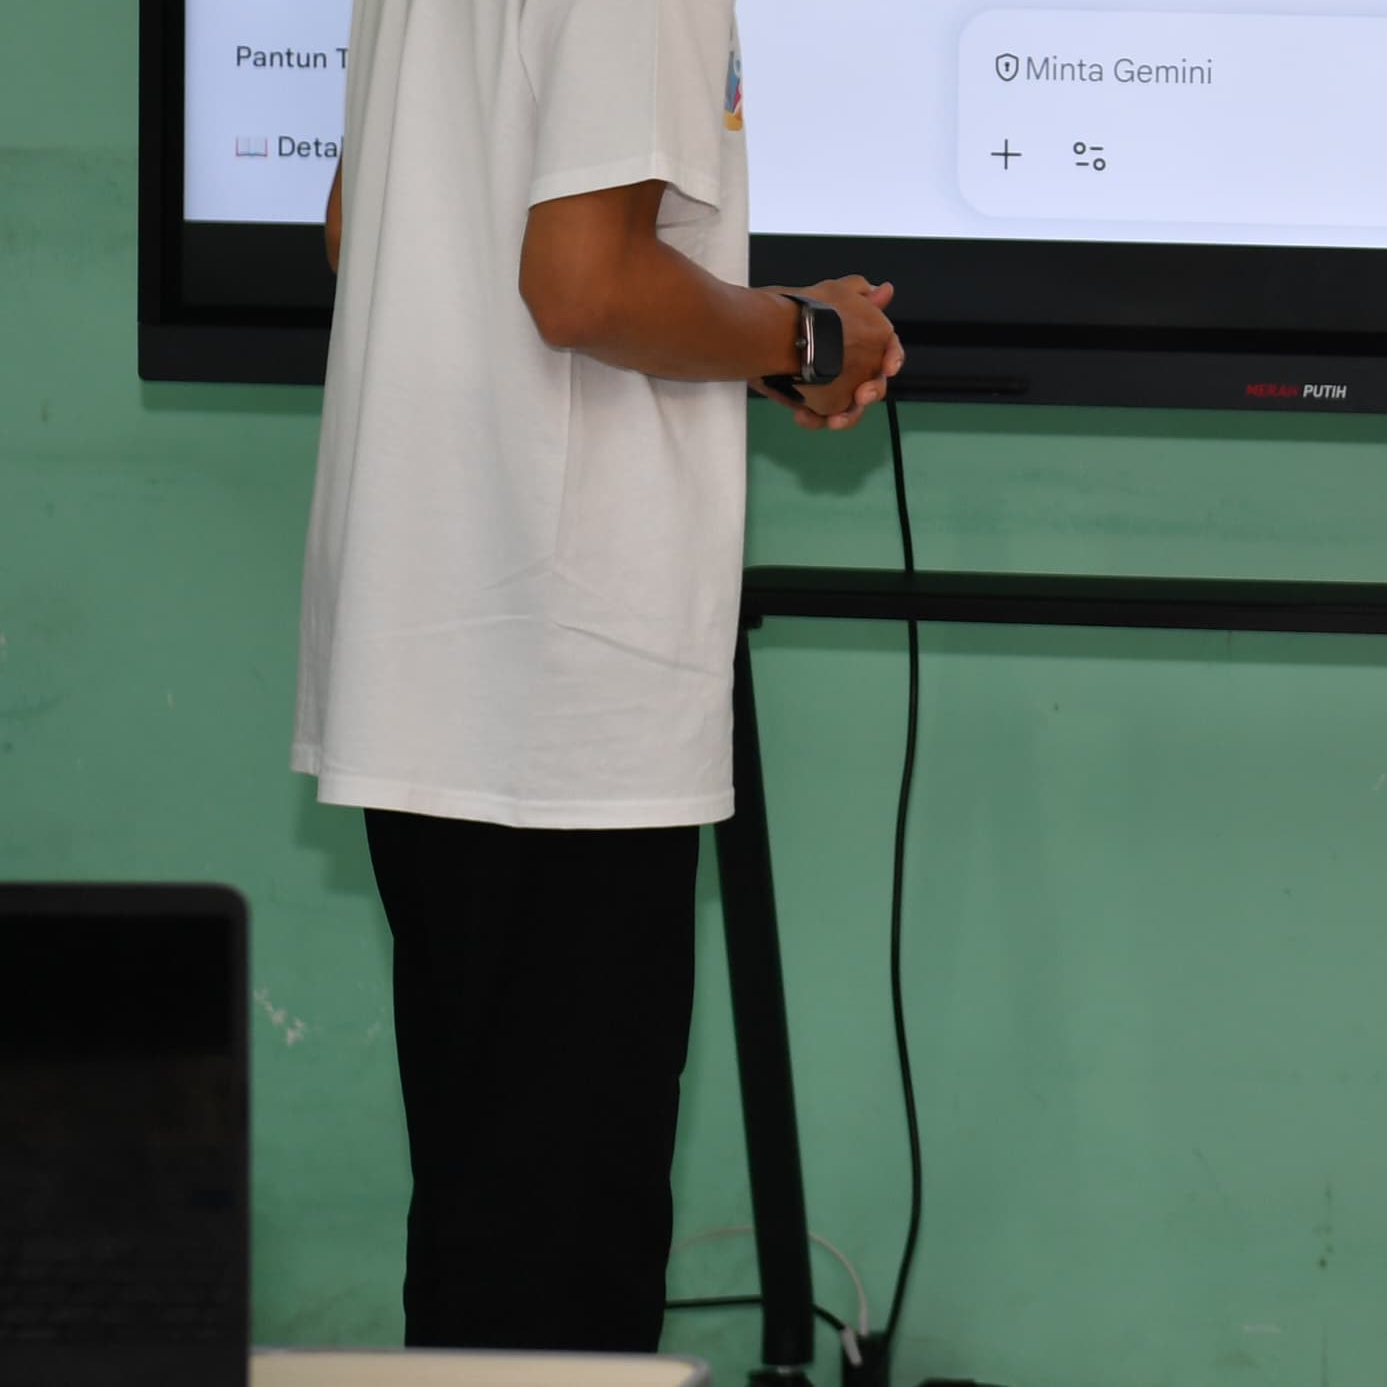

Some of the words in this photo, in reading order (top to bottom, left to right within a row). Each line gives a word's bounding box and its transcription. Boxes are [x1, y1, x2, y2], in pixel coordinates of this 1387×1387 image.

[236, 45, 327, 69] Pantun
[1026, 55, 1104, 83] Minta
[1113, 57, 1212, 85] Gemini
[1302, 384, 1347, 399] PUTIH
